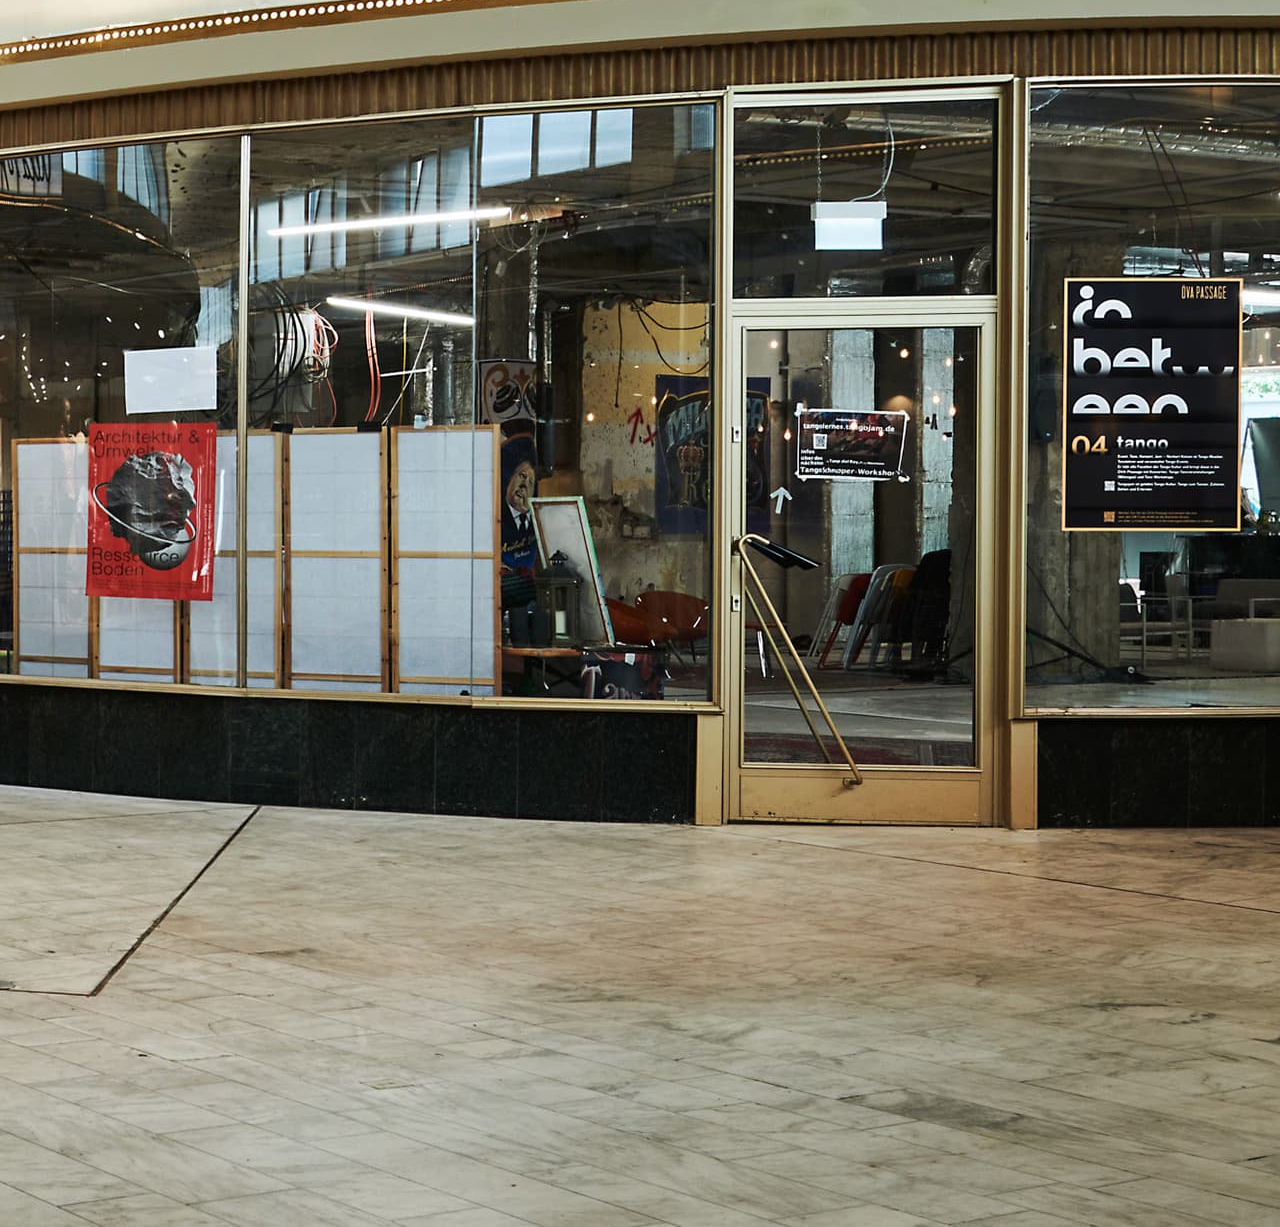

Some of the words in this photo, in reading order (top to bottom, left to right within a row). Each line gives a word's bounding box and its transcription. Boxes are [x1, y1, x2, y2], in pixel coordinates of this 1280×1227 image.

[1196, 285, 1228, 300] PASSAGE
[94, 430, 183, 444] Architektur
[188, 429, 200, 444] &
[1072, 435, 1108, 454] 04
[1116, 436, 1169, 449] tango
[91, 562, 144, 576] Boden
